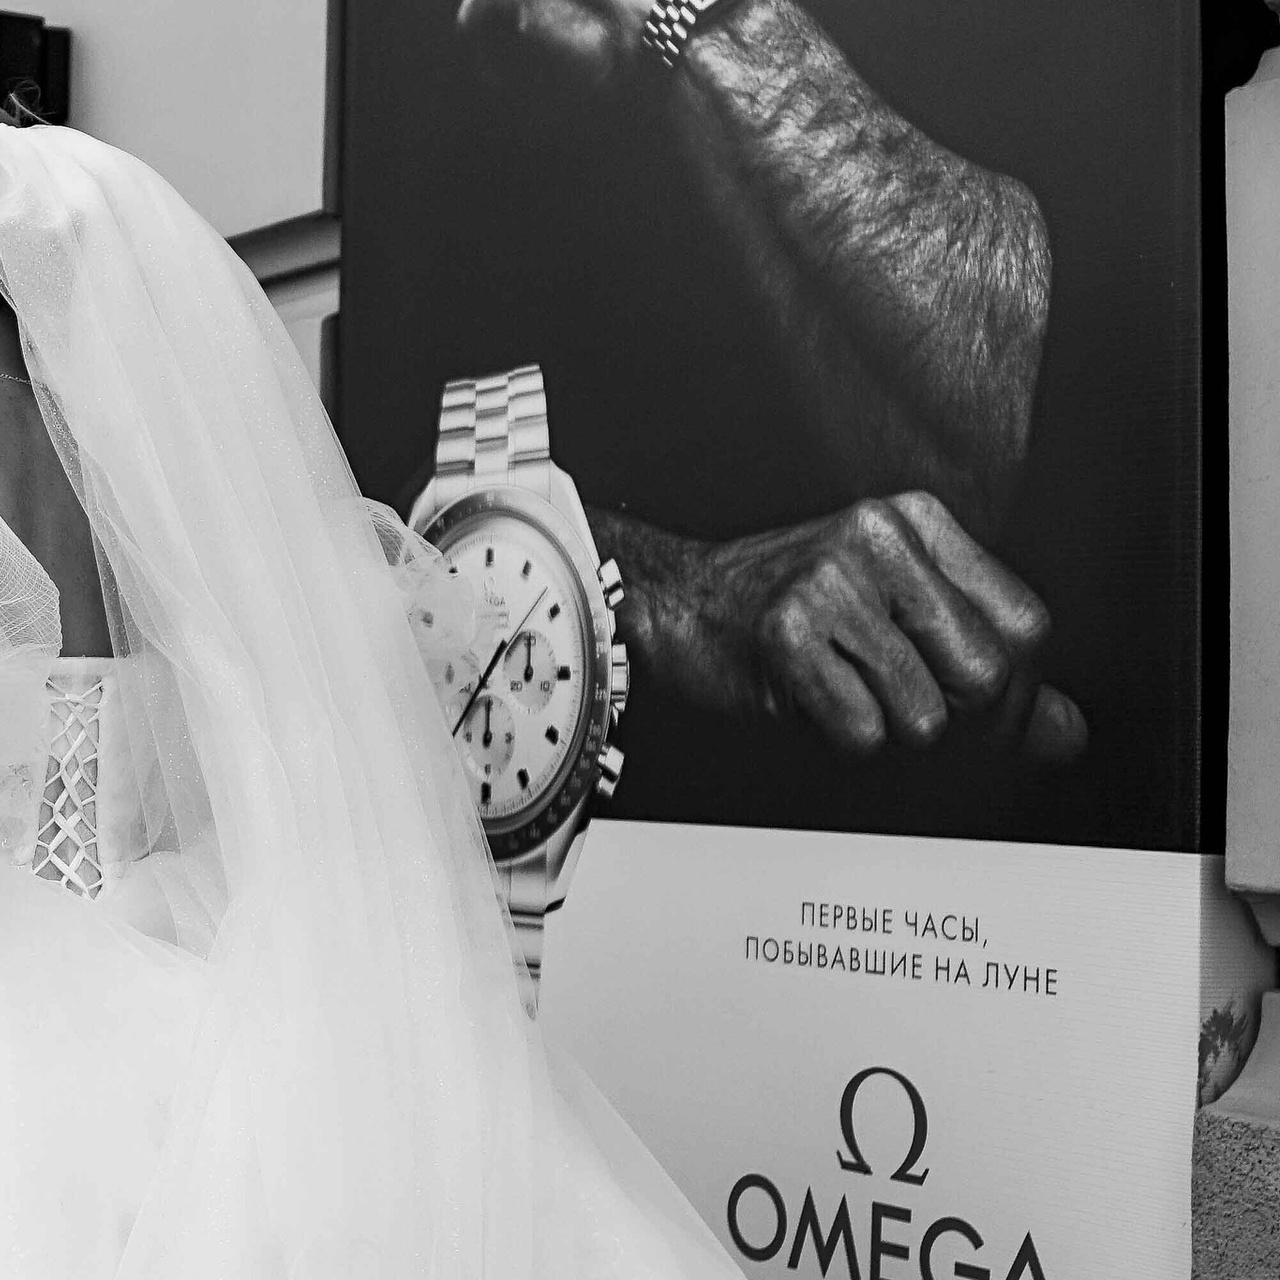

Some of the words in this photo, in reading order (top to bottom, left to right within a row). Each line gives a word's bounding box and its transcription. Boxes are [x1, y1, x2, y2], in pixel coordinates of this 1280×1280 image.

[800, 901, 894, 934] ПЕРВЫЕ
[904, 910, 989, 949] ЧАСЫ,
[745, 935, 924, 980] ПОБЫВАВШИЕ
[934, 955, 971, 985] НА
[981, 961, 1059, 996] ЛУНЕ
